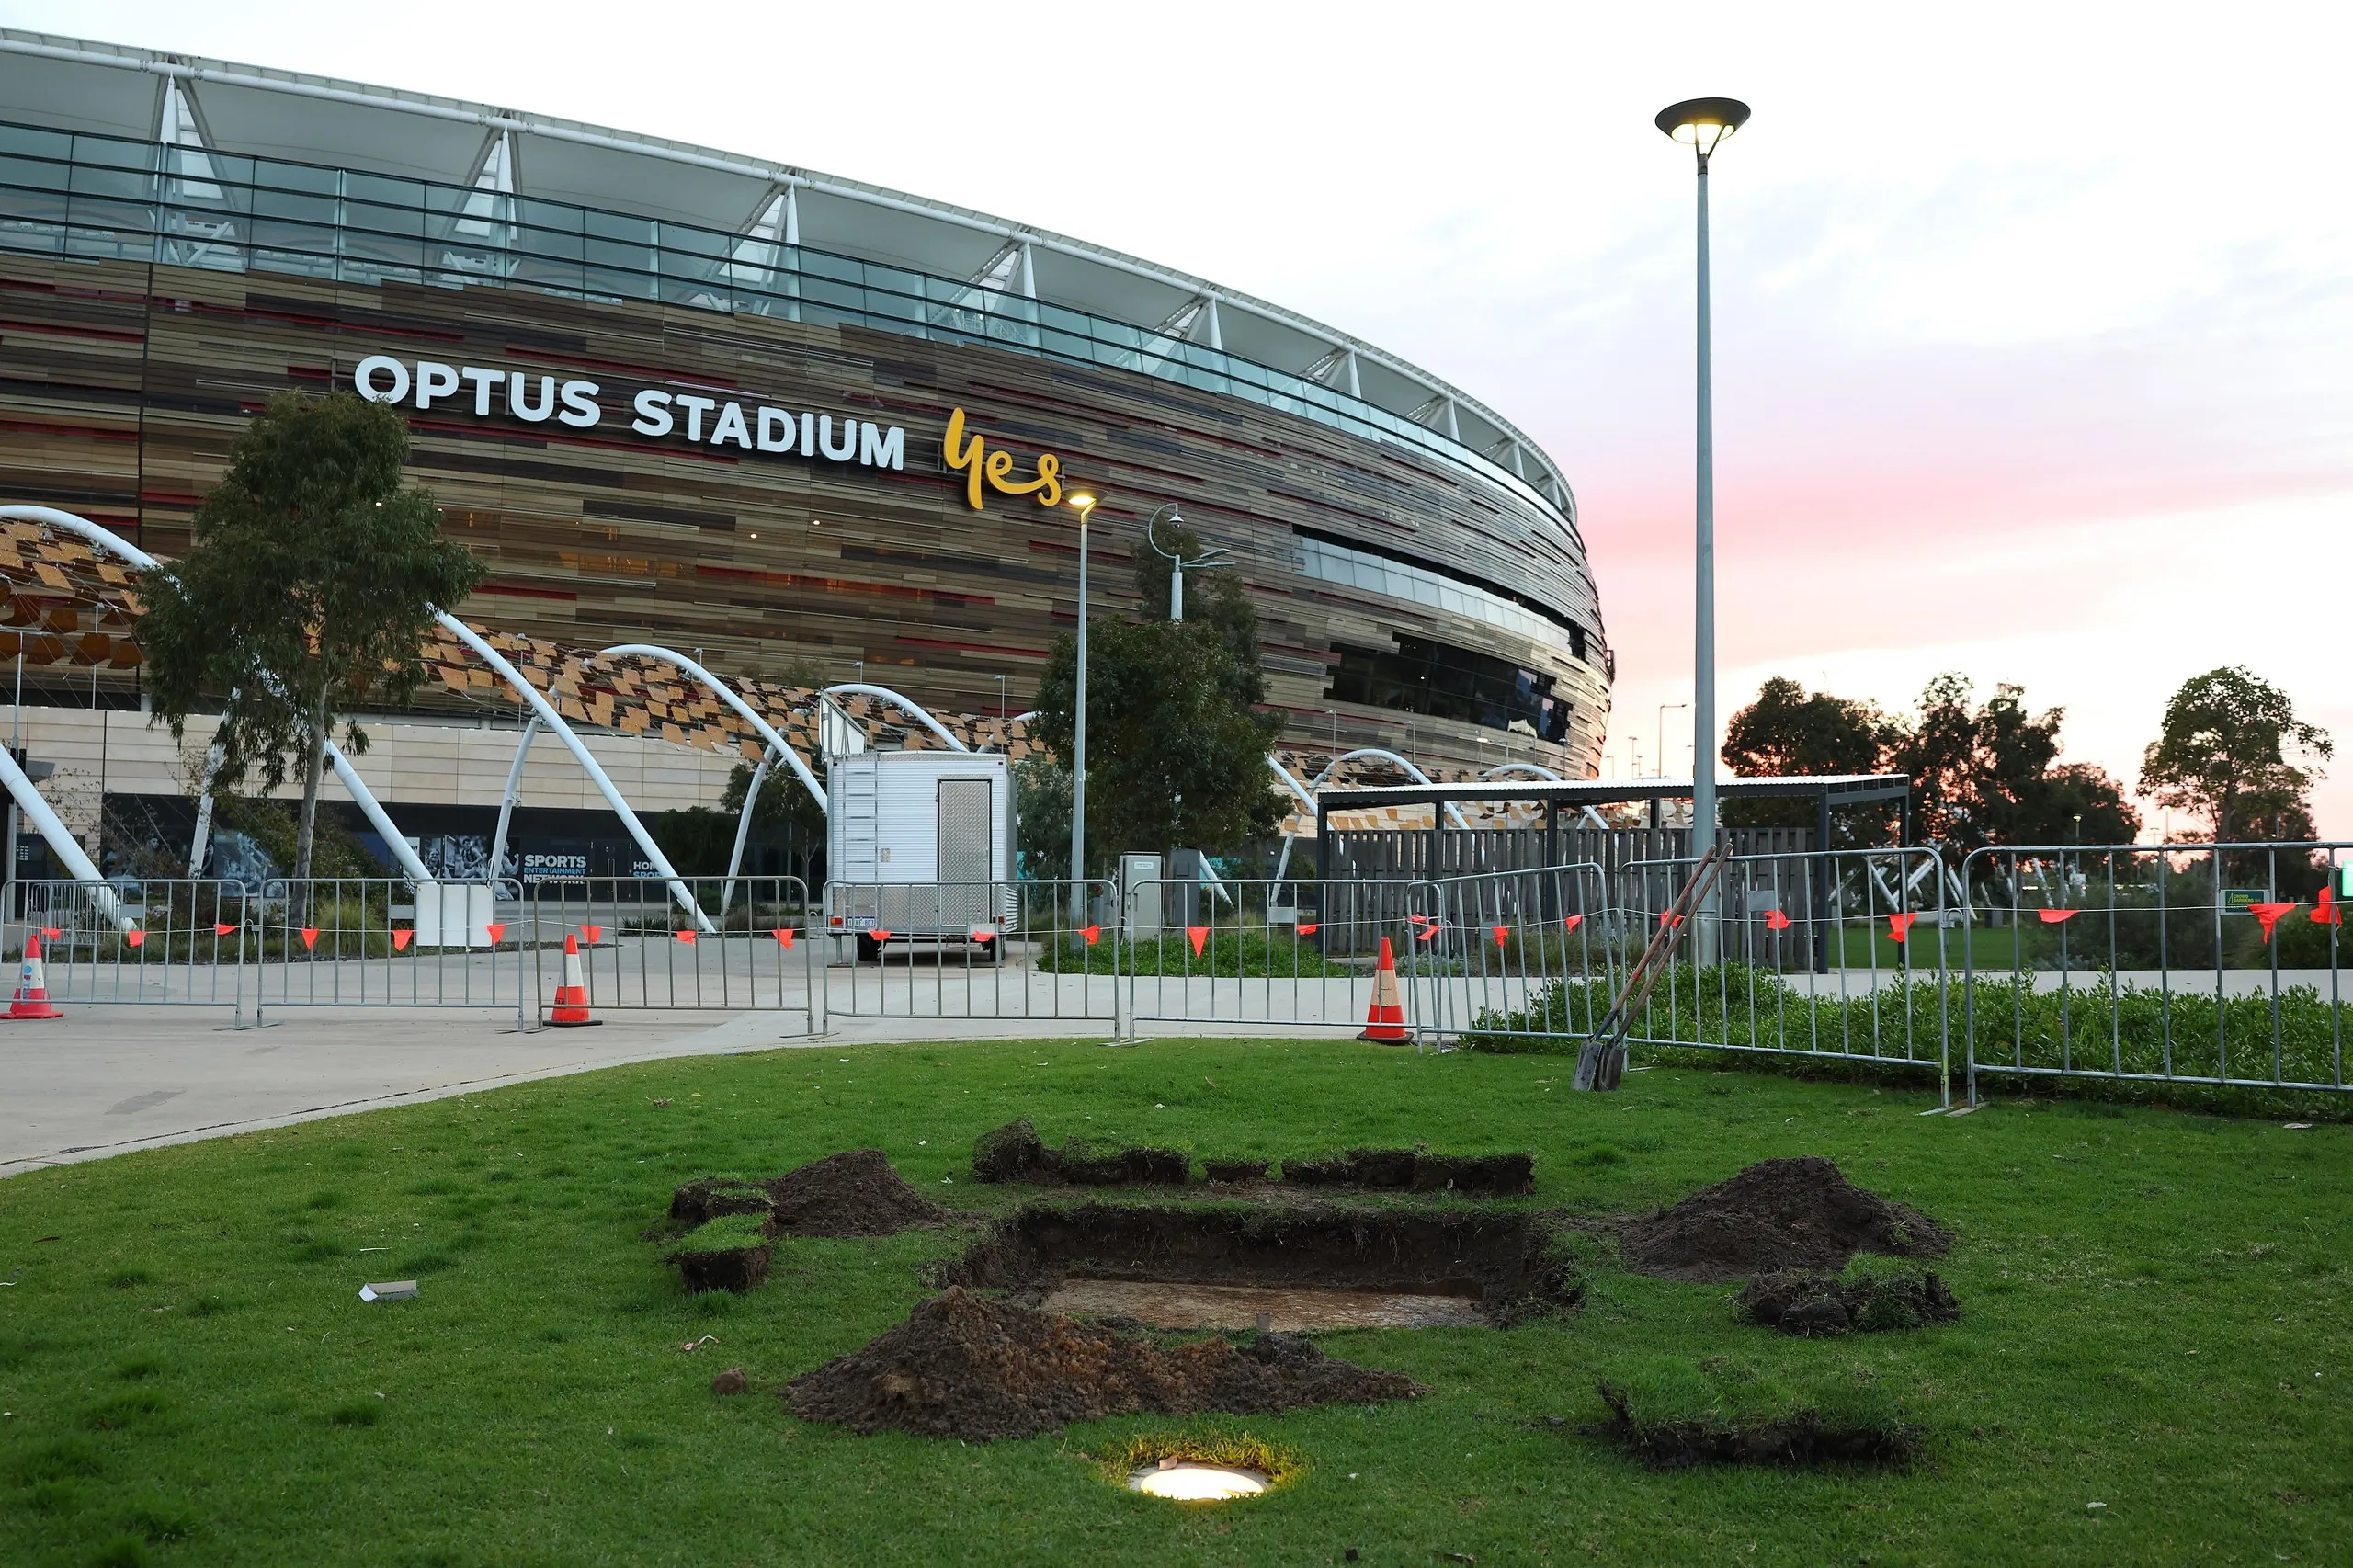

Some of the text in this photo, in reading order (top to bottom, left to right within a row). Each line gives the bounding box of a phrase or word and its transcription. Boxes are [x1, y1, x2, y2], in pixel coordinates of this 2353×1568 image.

[354, 355, 601, 427] OPTUS
[631, 389, 904, 471] STADIUM
[524, 854, 586, 868] SPORTS
[523, 867, 587, 875] ENTERTAINMENT
